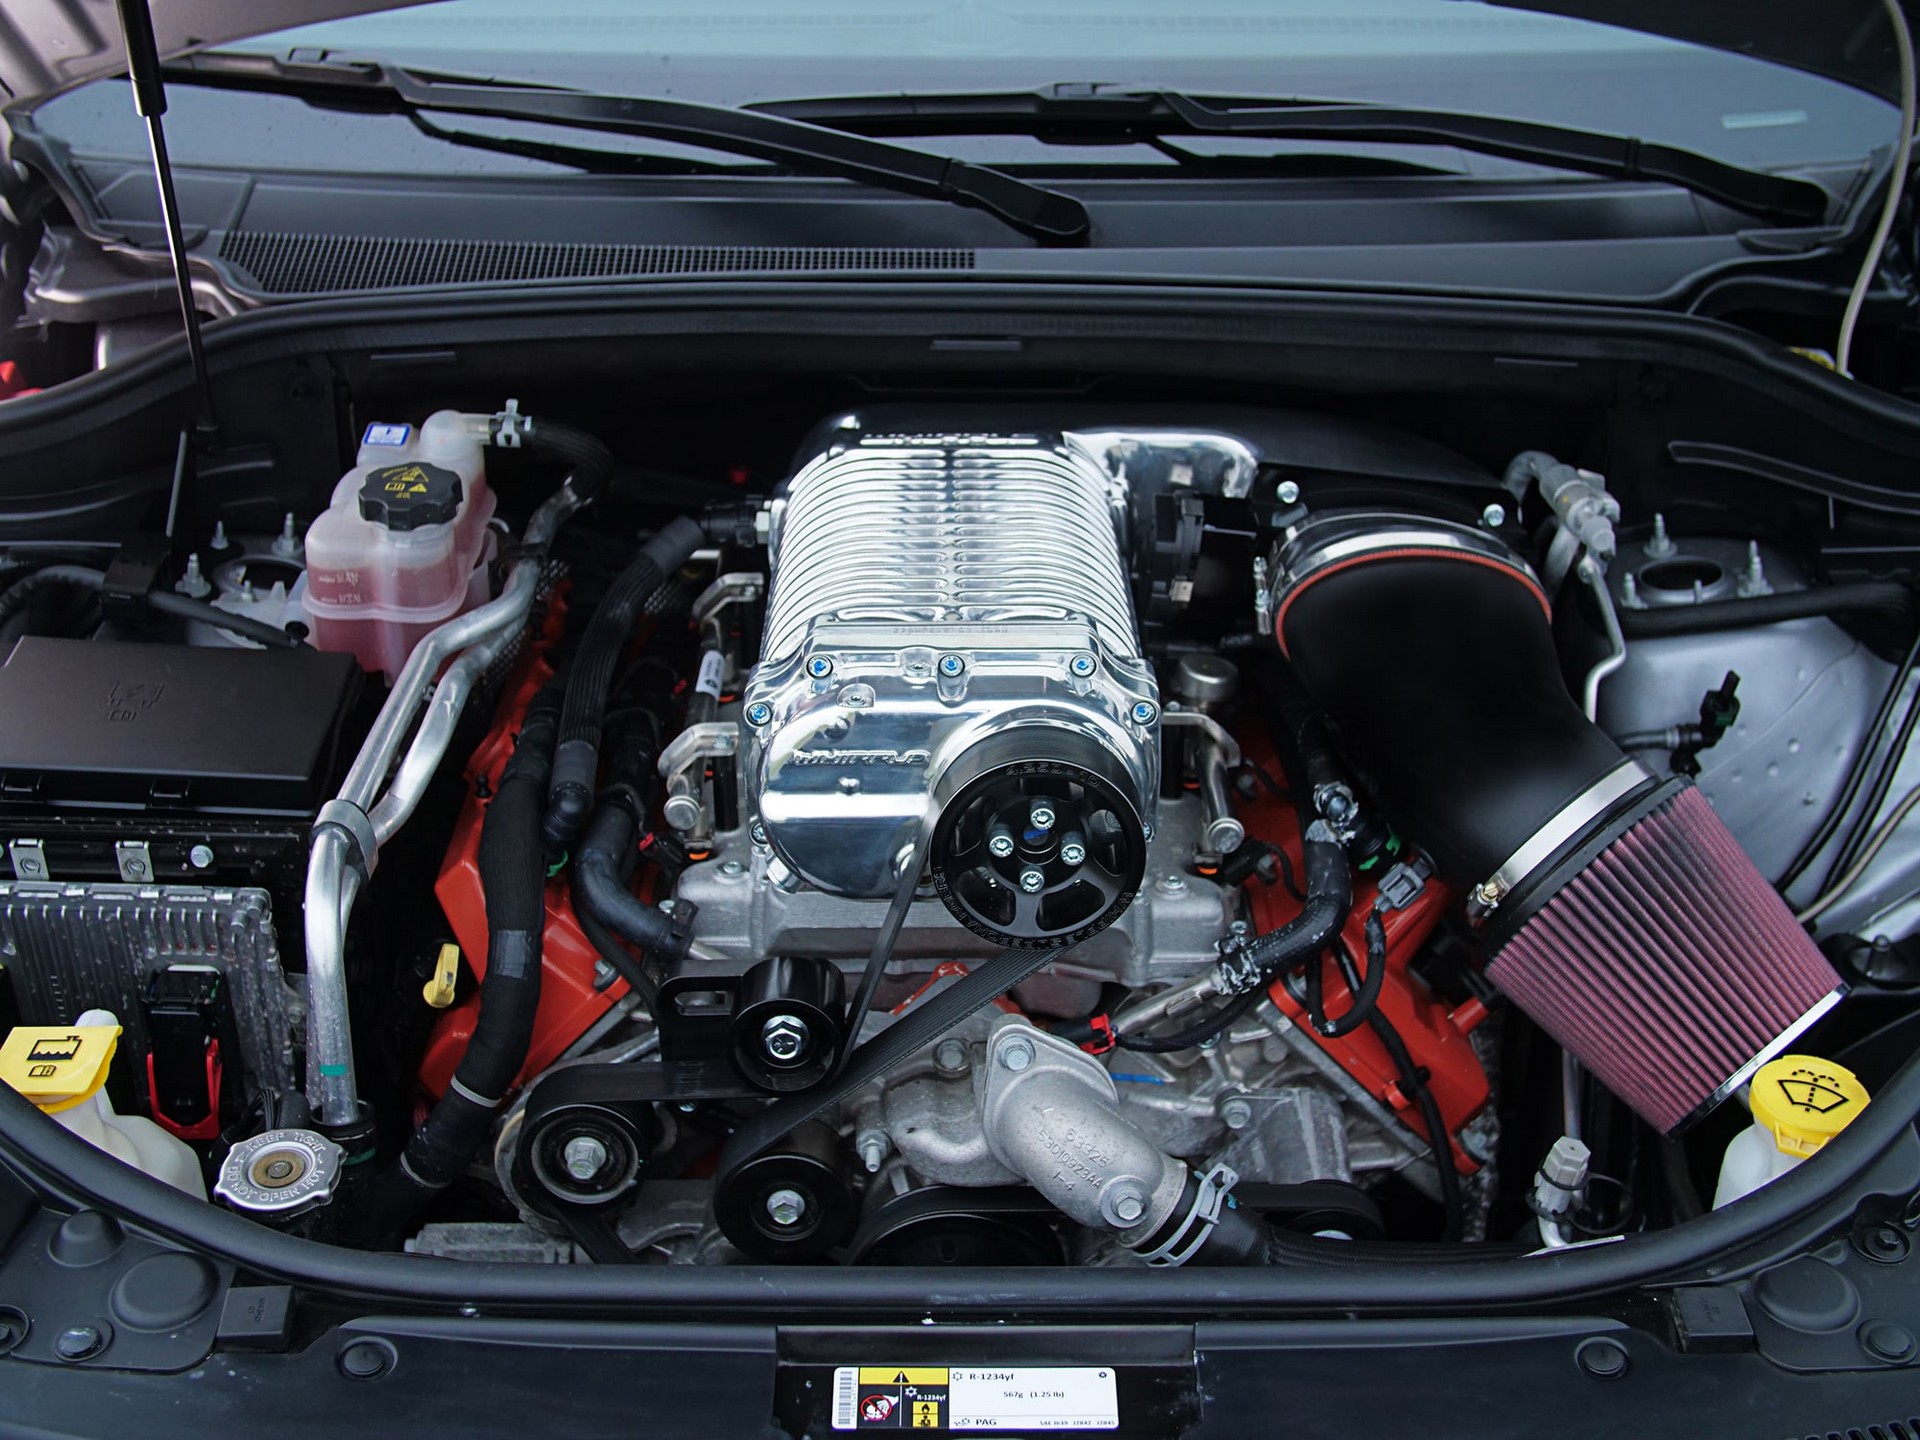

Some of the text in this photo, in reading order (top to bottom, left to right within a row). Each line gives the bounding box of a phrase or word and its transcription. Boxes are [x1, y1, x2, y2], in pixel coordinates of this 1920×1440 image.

[245, 1132, 285, 1152] KEEP
[259, 1189, 301, 1202] OPEN
[302, 1170, 326, 1190] HOT
[969, 1372, 1015, 1381] R-1234yf
[1003, 1391, 1024, 1399] 567g
[975, 1418, 997, 1426] PAG
